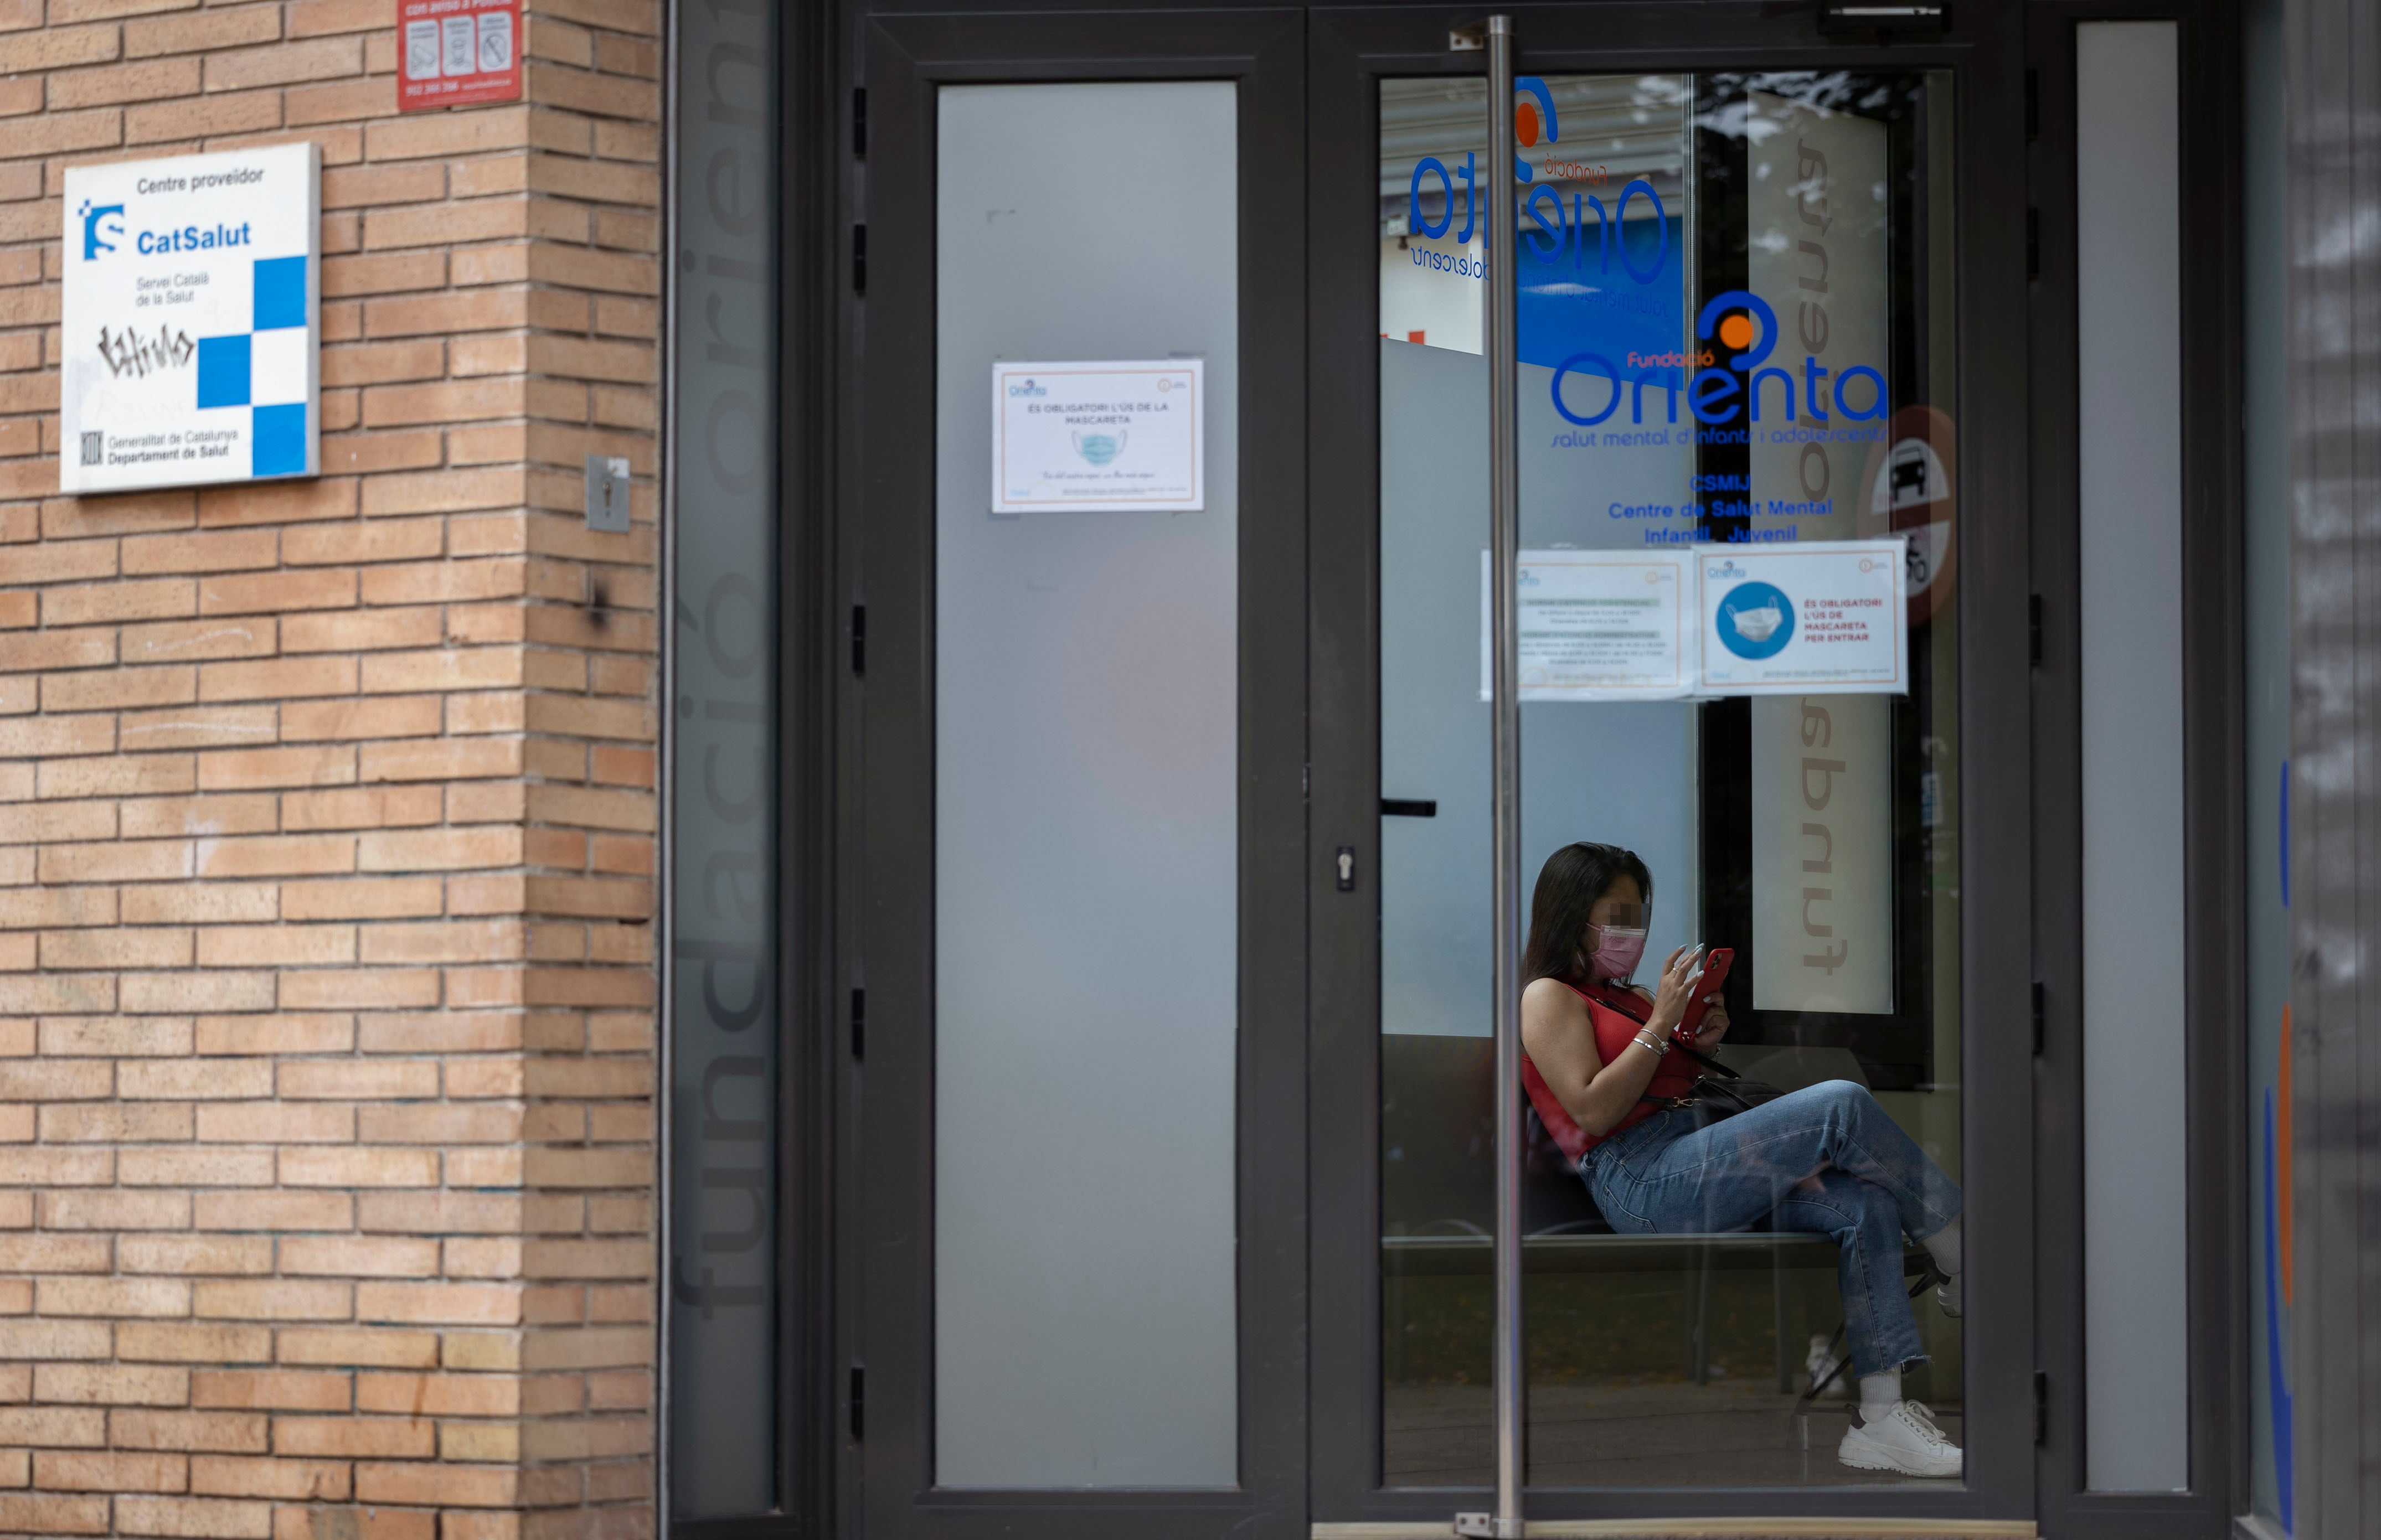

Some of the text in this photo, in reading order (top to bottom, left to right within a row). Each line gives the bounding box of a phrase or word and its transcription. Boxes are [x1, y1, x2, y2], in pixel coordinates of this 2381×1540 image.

[137, 168, 264, 194] Centre proveïdor
[137, 222, 251, 255] CatSalut
[137, 272, 210, 291] Servei Català
[137, 291, 194, 307] de la Salut
[1627, 349, 1715, 368] Fundació
[1552, 352, 1888, 426] Orienta
[1044, 403, 1110, 414] OBLIGATORI
[1137, 402, 1151, 412] DE
[1154, 402, 1169, 412] LA
[1065, 415, 1131, 425] MASCARETA
[107, 429, 239, 449] Generalitat de Catalunya
[1550, 432, 1597, 448] salut
[1602, 429, 1669, 447] mental
[1676, 428, 1753, 445] d'infants
[1770, 426, 1888, 443] adolescents
[108, 444, 229, 467] Departament de Salut
[1689, 473, 1750, 492] CSMIJ
[1608, 498, 1833, 519] Centre de Salut Mental
[1644, 524, 1797, 544] Infantil Juvenil
[1820, 598, 1883, 608] OBLIGATORI
[1804, 622, 1867, 632] MASCARETA
[1805, 633, 1869, 643] PER ENTRAR
